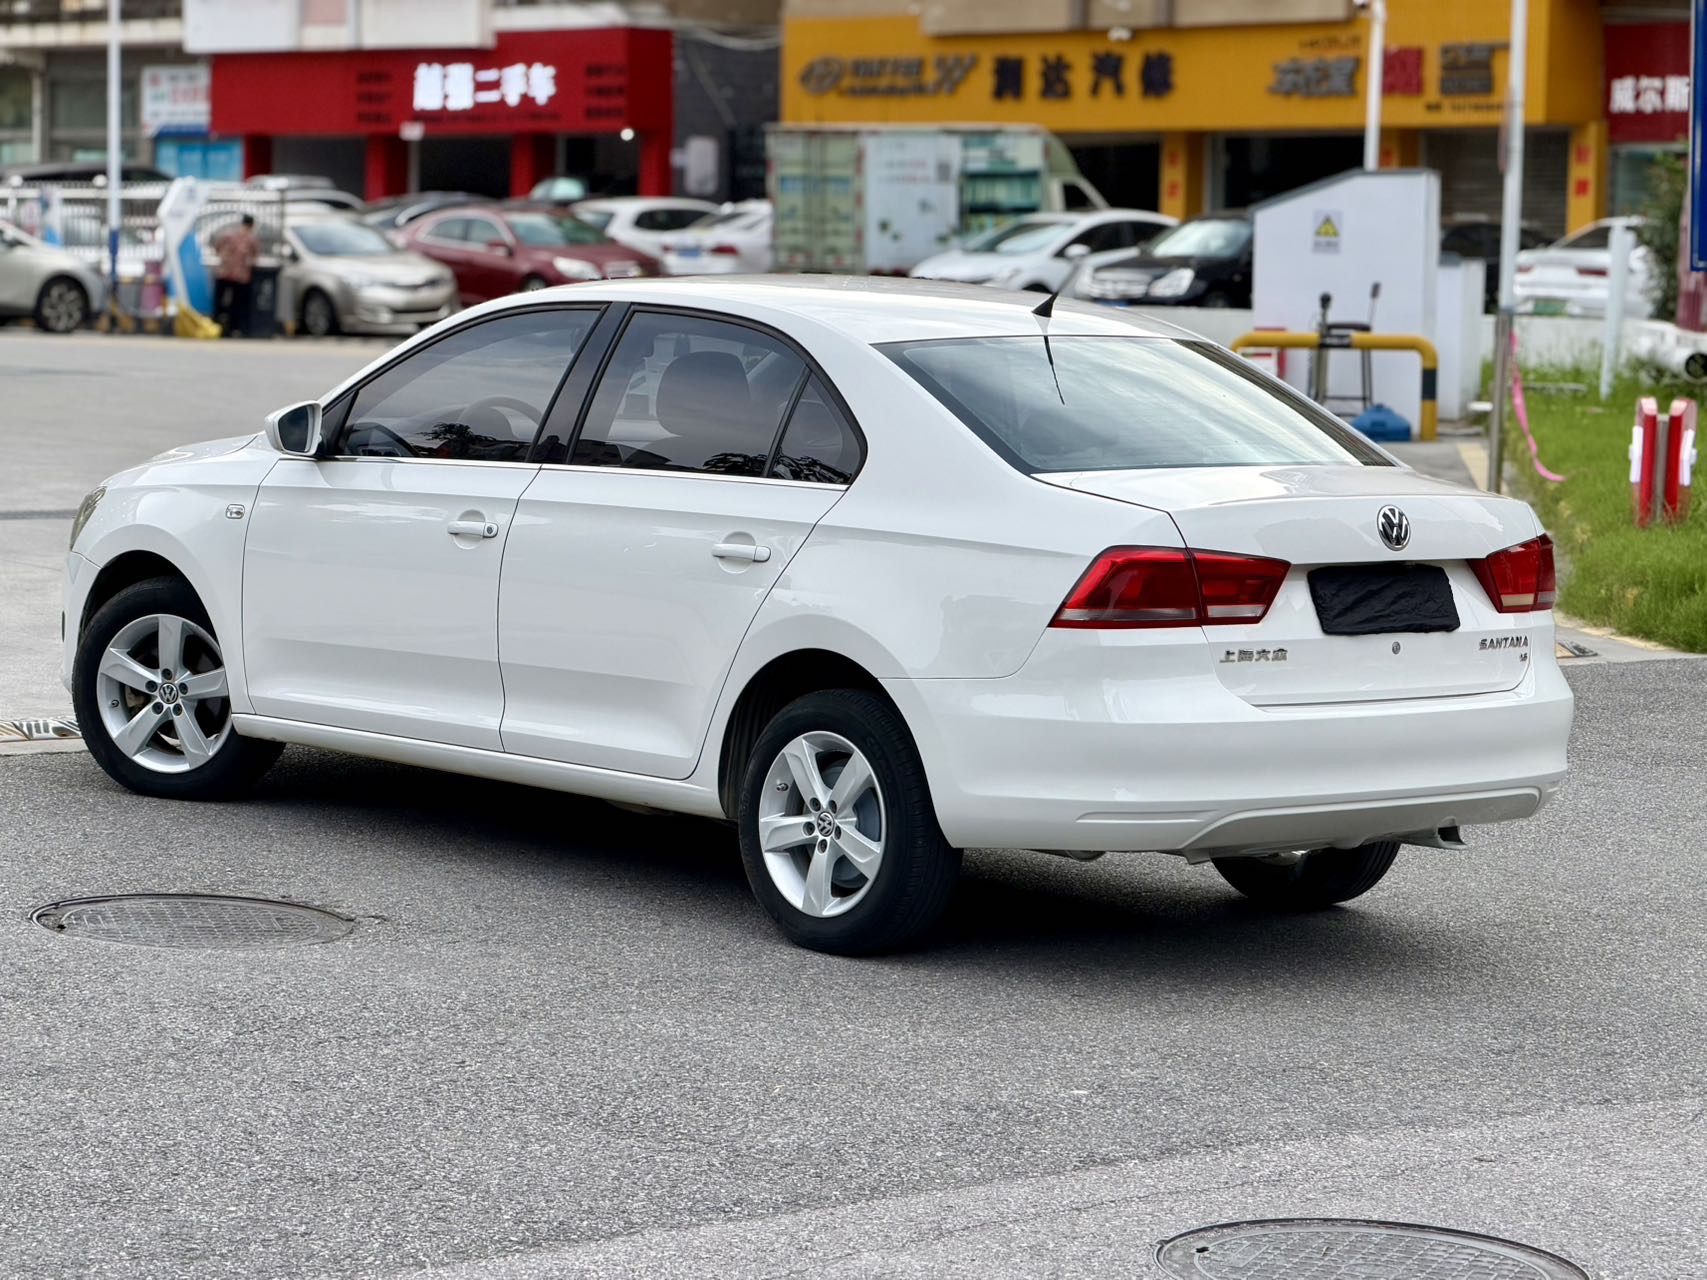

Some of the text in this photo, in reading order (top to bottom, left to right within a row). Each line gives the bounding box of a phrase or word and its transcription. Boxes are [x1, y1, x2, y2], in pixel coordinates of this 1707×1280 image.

[413, 63, 556, 111] 二手车
[1479, 635, 1529, 651] SANTANA
[1219, 648, 1288, 663] 上海大众
